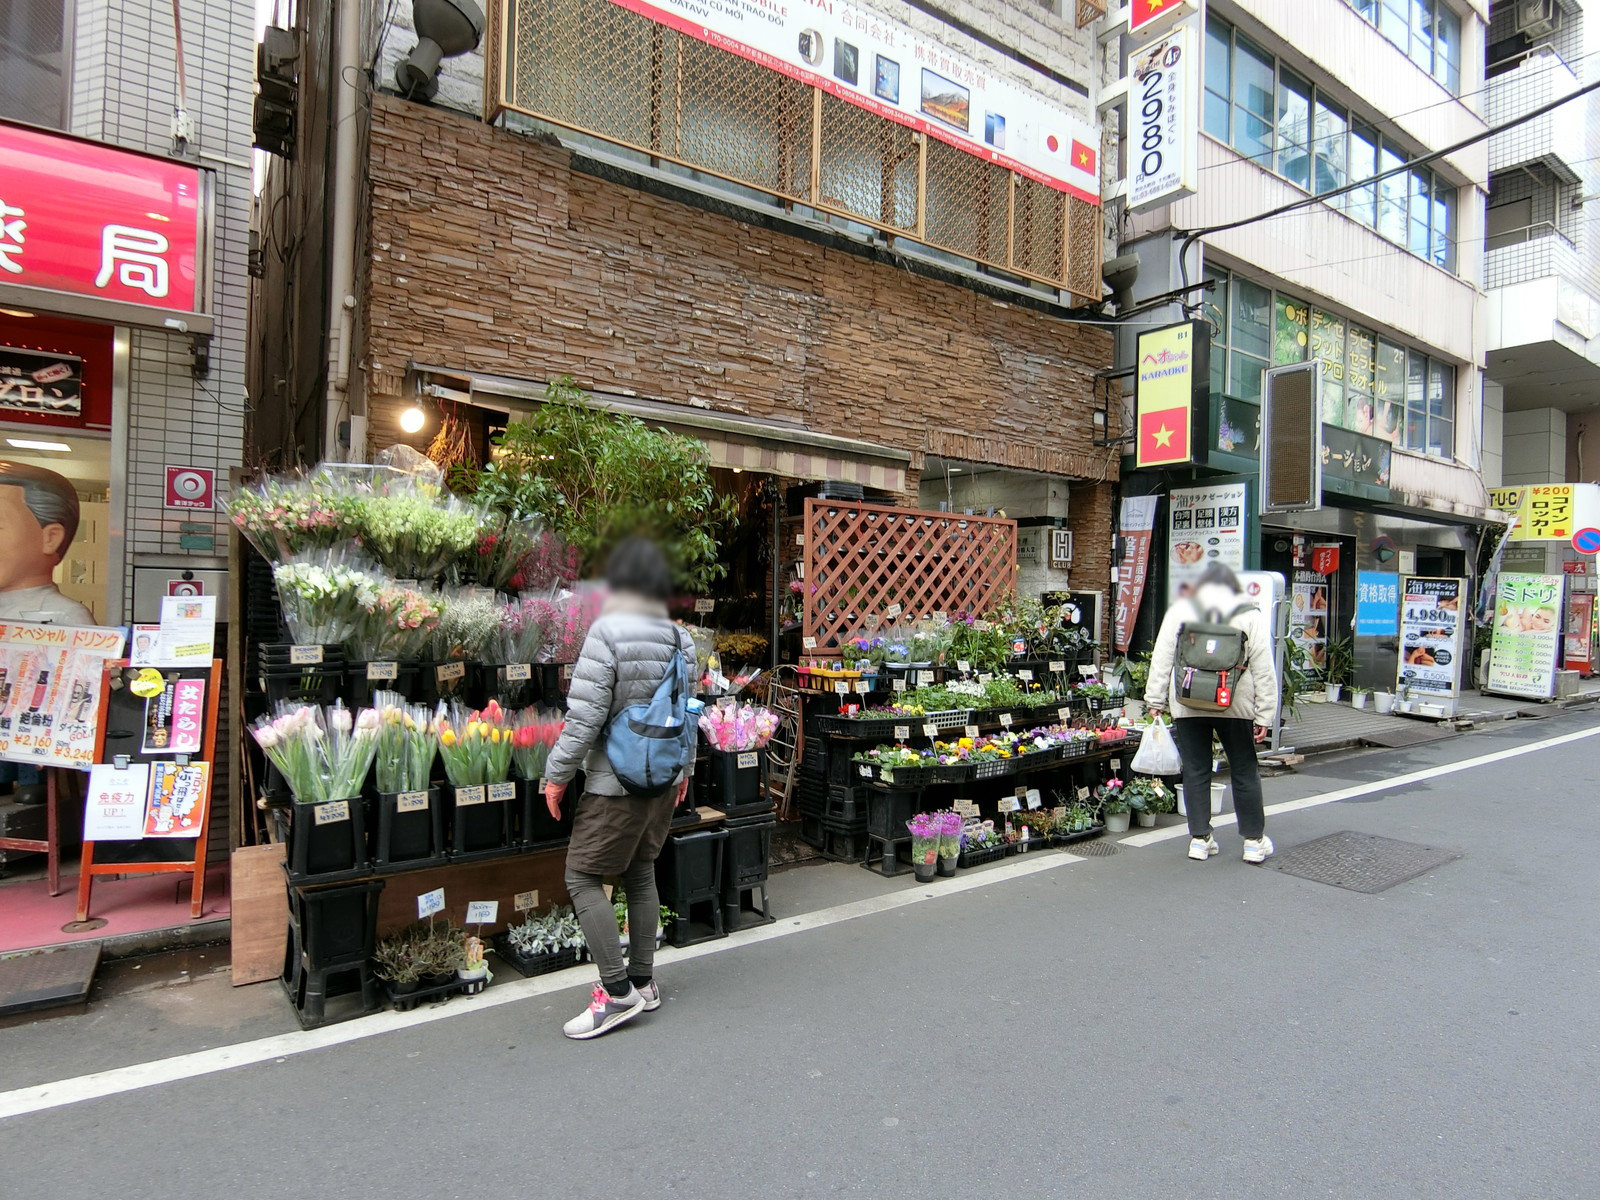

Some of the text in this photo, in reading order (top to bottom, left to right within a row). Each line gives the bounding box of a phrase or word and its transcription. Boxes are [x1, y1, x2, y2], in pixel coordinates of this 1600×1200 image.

[1177, 332, 1188, 340] B1
[1393, 348, 1405, 365] 2F
[1141, 363, 1188, 382] KARAOKE
[1531, 501, 1549, 536] ロッカー
[1552, 497, 1569, 523] コイン
[1052, 561, 1072, 569] CLUB
[1359, 583, 1397, 605] 資格取得
[1502, 586, 1554, 604] ミドリ
[11, 627, 120, 648] スペシャル ドリンク
[98, 792, 135, 804] 免疫力
